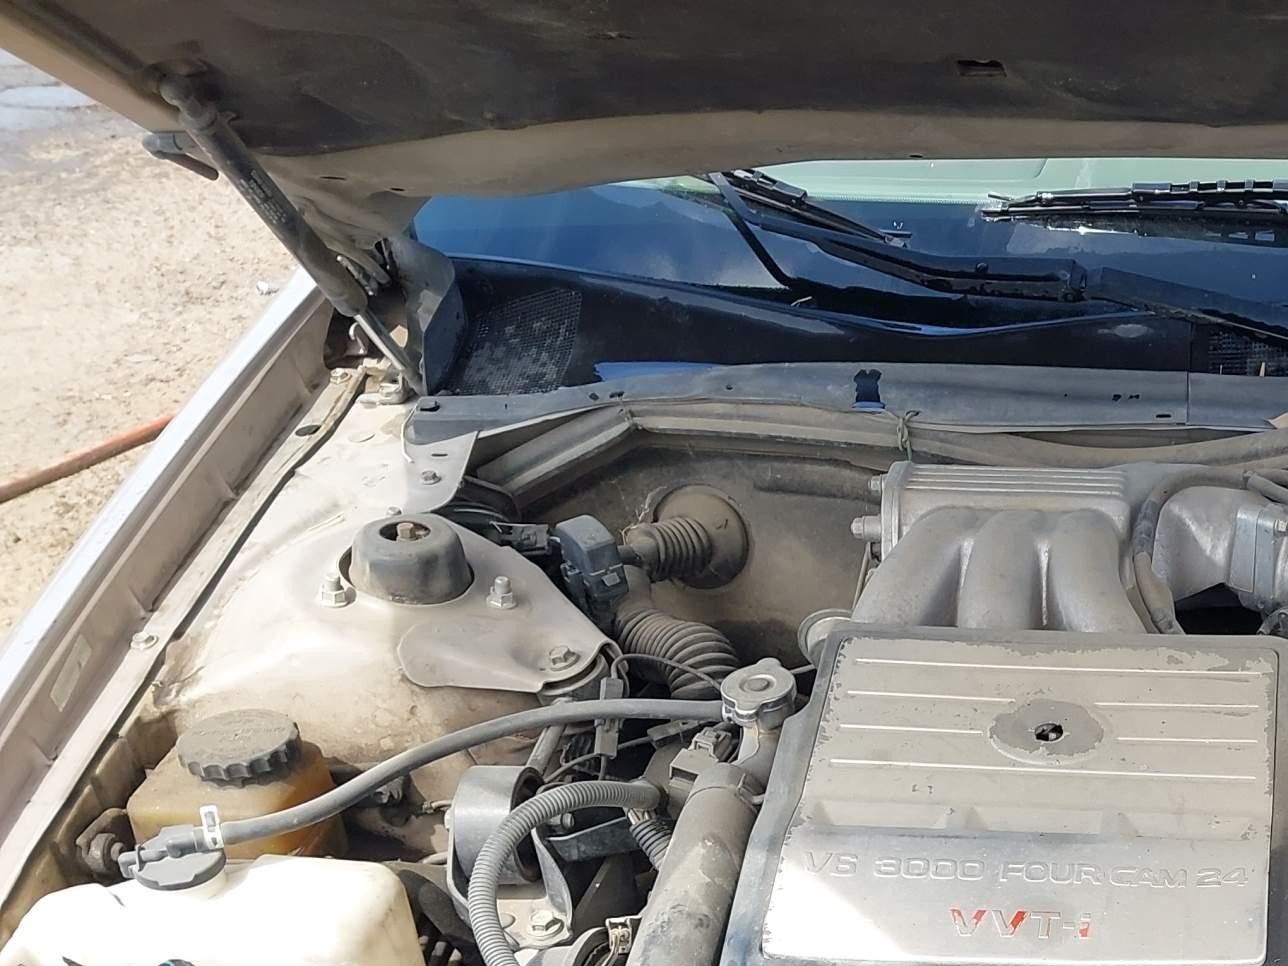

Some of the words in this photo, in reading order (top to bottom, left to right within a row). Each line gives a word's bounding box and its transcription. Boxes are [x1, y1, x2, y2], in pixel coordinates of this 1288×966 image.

[803, 851, 858, 876] V6
[872, 855, 985, 881] 3000
[998, 861, 1102, 886] FOUR
[1108, 866, 1187, 888] CAM
[1196, 867, 1248, 888] 24
[950, 907, 1092, 939] VVT-i
